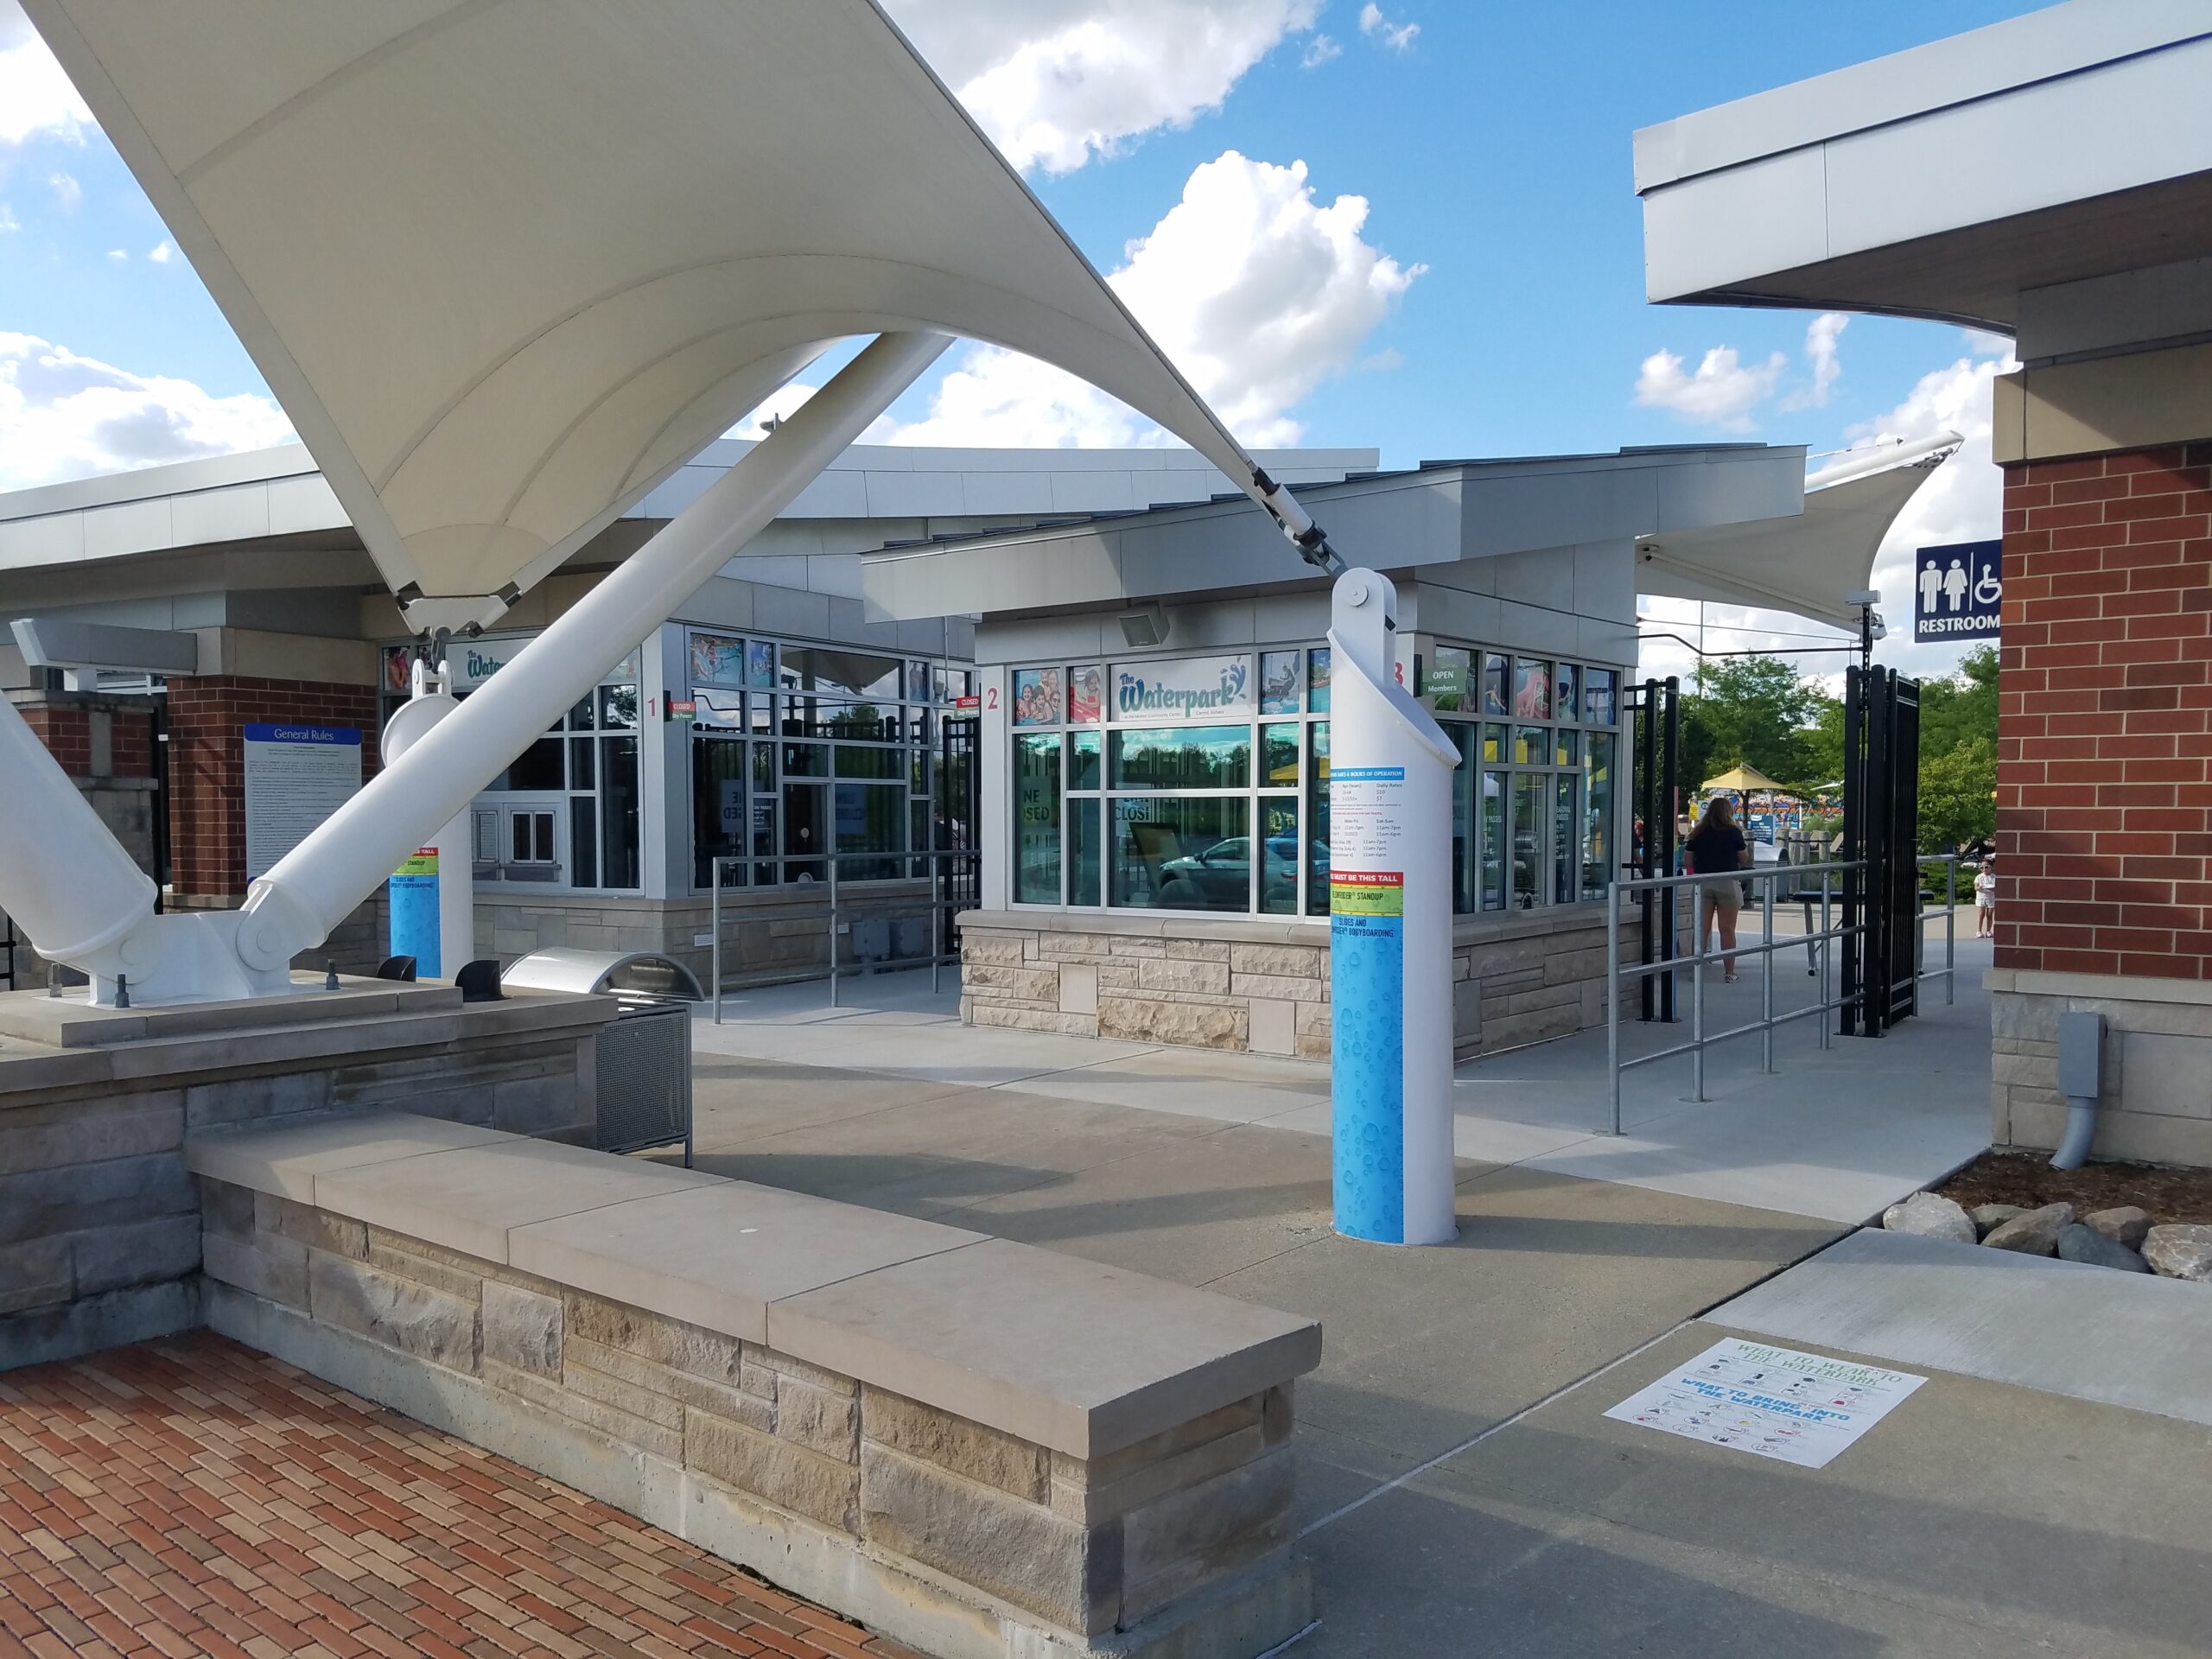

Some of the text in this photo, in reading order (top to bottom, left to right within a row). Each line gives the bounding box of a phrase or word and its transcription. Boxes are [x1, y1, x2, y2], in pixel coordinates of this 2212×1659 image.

[1119, 672, 1135, 685] The
[1433, 671, 1454, 680] OPEN
[988, 687, 998, 709] 2
[1119, 676, 1235, 719] Waterpark
[648, 697, 656, 717] 1
[274, 728, 334, 741] General Rules
[1024, 790, 1039, 803] NE
[1023, 807, 1050, 821] SED
[1115, 807, 1149, 821] CLOS
[1357, 892, 1383, 901] STANDUP
[1338, 918, 1367, 927] SLIDES AND
[1348, 927, 1394, 938] BODYBOARDING
[1738, 1344, 1783, 1358] WHAT
[1793, 1355, 1815, 1365] TO
[1822, 1362, 1870, 1376] WEAR
[1879, 1373, 1903, 1383] TO
[1743, 1352, 1776, 1363] THE
[1782, 1360, 1880, 1386] WATERPARK
[1681, 1377, 1726, 1391] WHAT
[1728, 1389, 1748, 1397] TO
[1751, 1394, 1802, 1410] BRING
[1810, 1408, 1851, 1421] INTO
[1696, 1387, 1727, 1398] THE
[1731, 1395, 1827, 1422] WATERPARK
